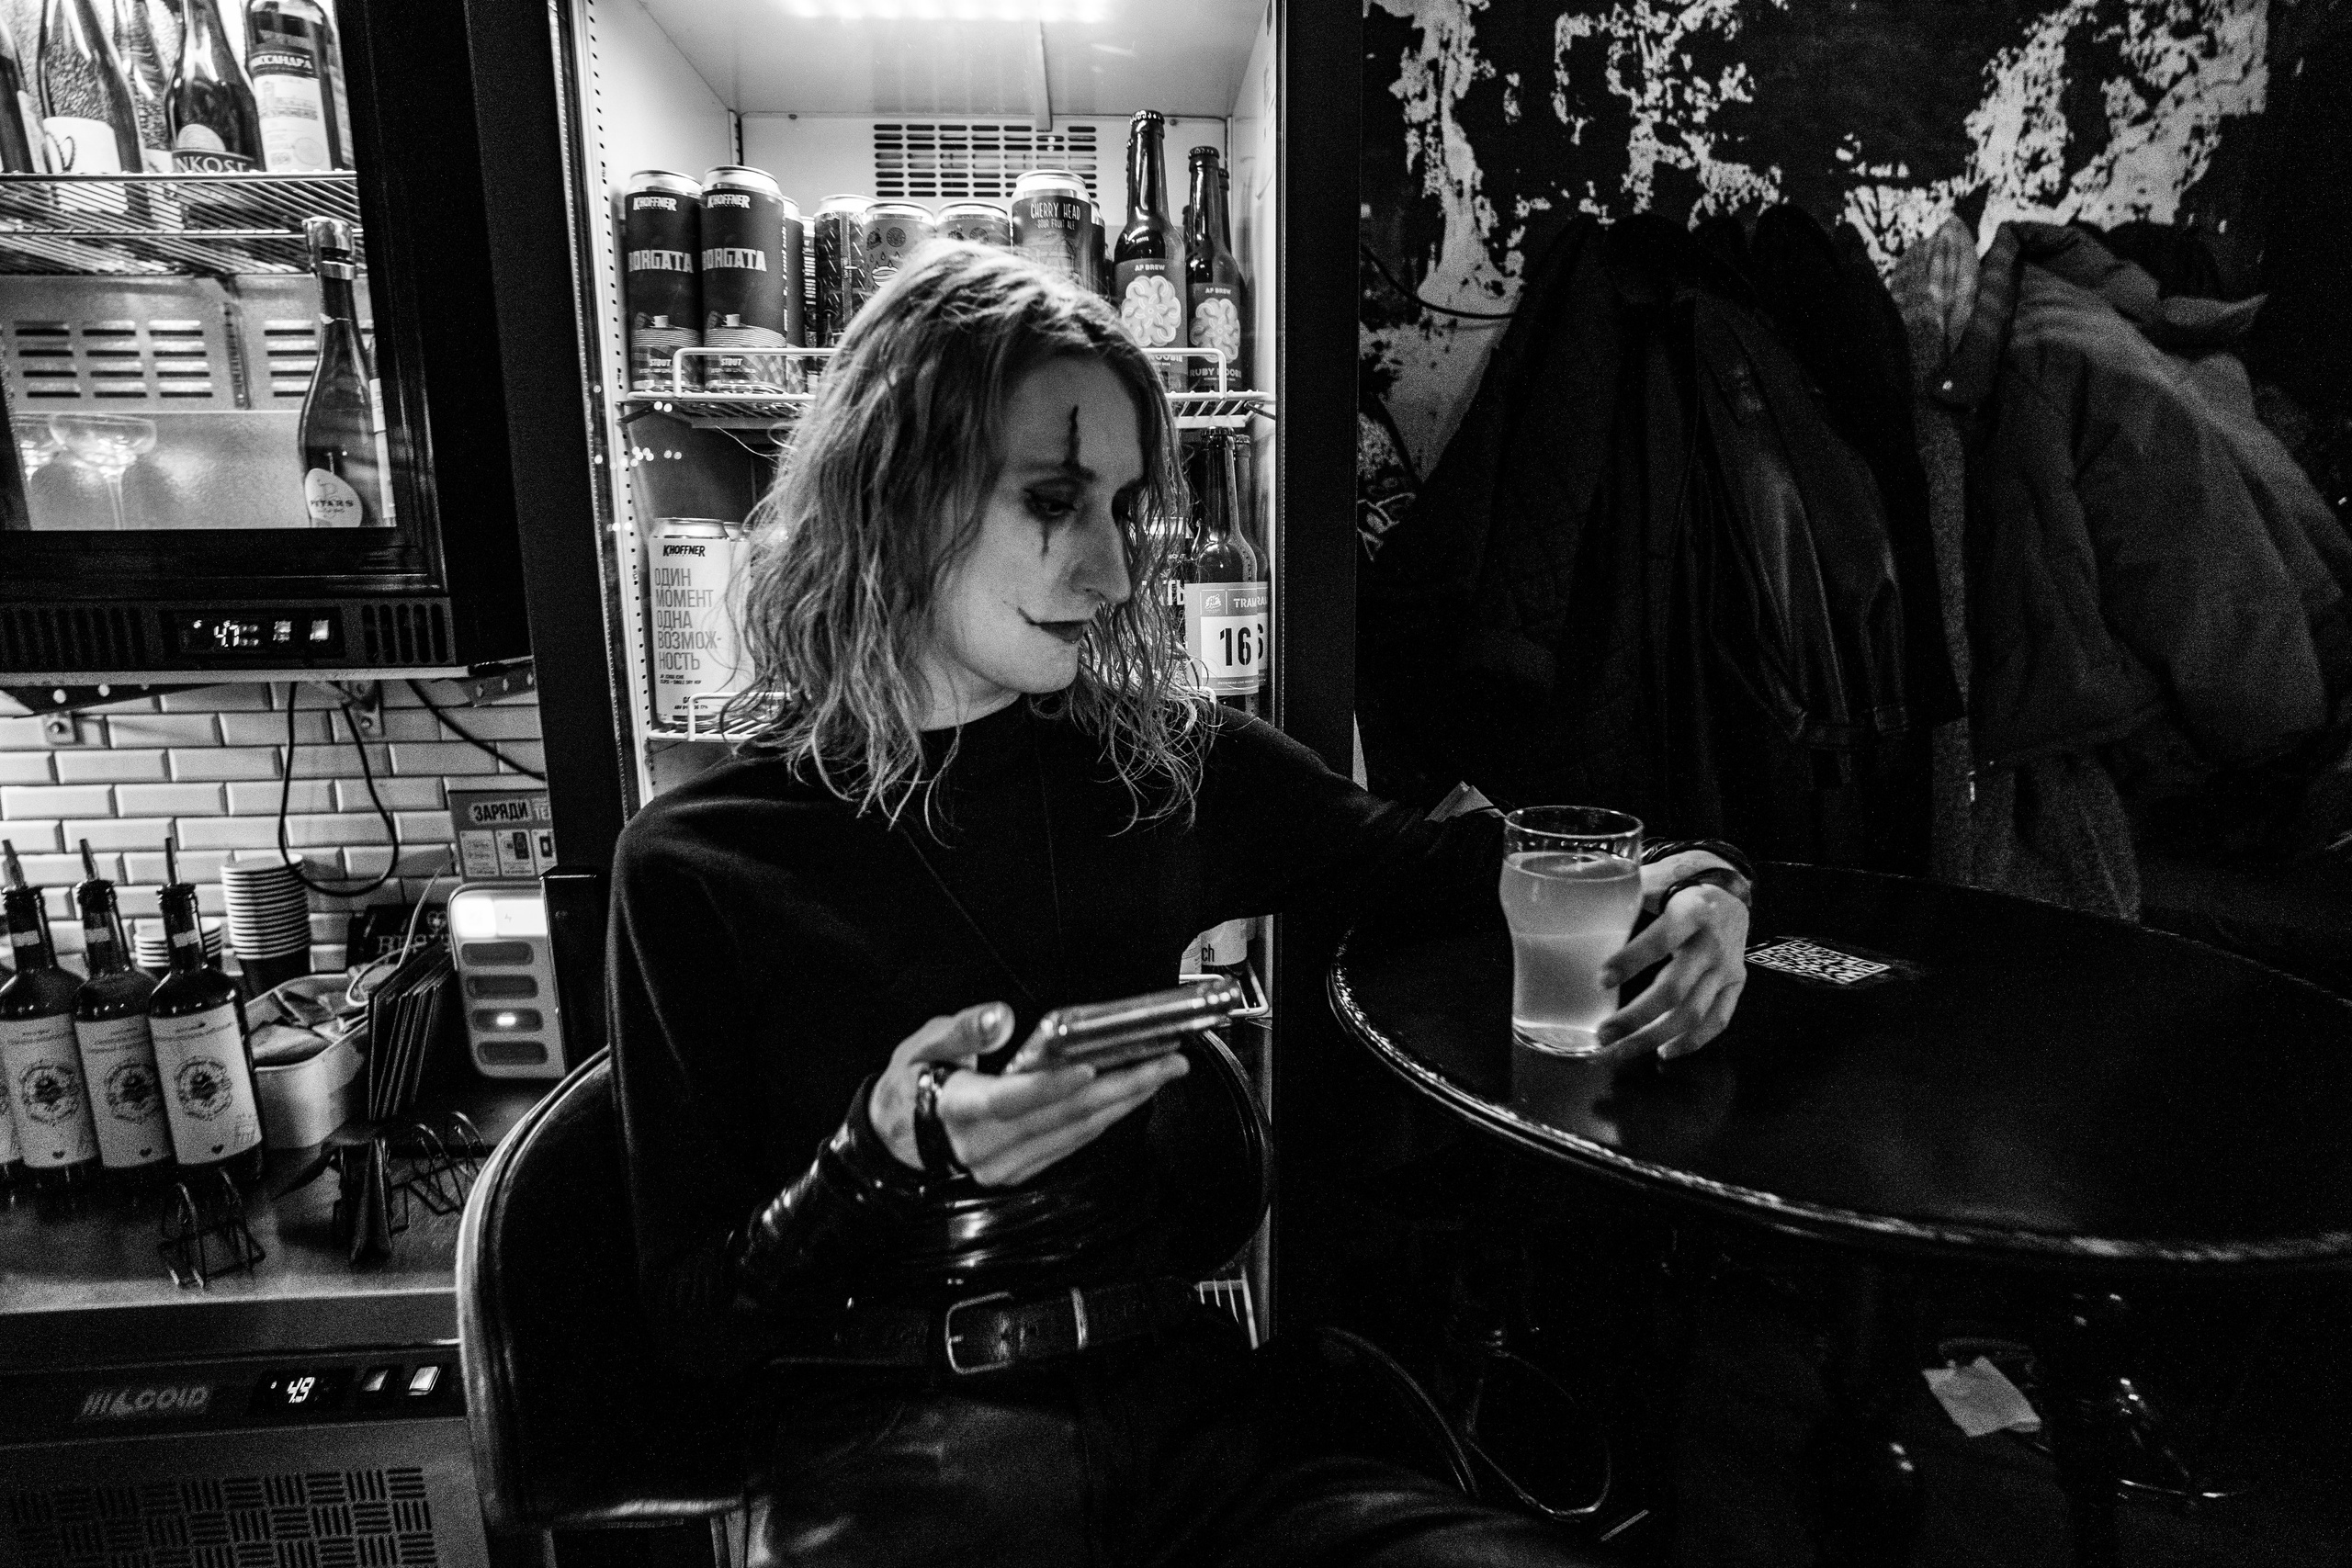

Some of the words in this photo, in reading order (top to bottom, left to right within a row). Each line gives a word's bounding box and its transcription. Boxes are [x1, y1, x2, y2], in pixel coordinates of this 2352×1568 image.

[1031, 202, 1058, 219] CHERRY
[1063, 203, 1080, 220] HEAD
[1190, 367, 1215, 377] RUBY
[663, 545, 706, 557] KHOFFNER
[654, 568, 691, 588] ОДИН
[656, 590, 713, 607] МОМЕНТ
[657, 610, 693, 630] ОДНА
[658, 631, 721, 649] ВОЗМОЖ-
[1220, 626, 1251, 667] 16
[659, 651, 700, 671] НОСТЬ
[473, 802, 529, 822] ЗАРЯДИ
